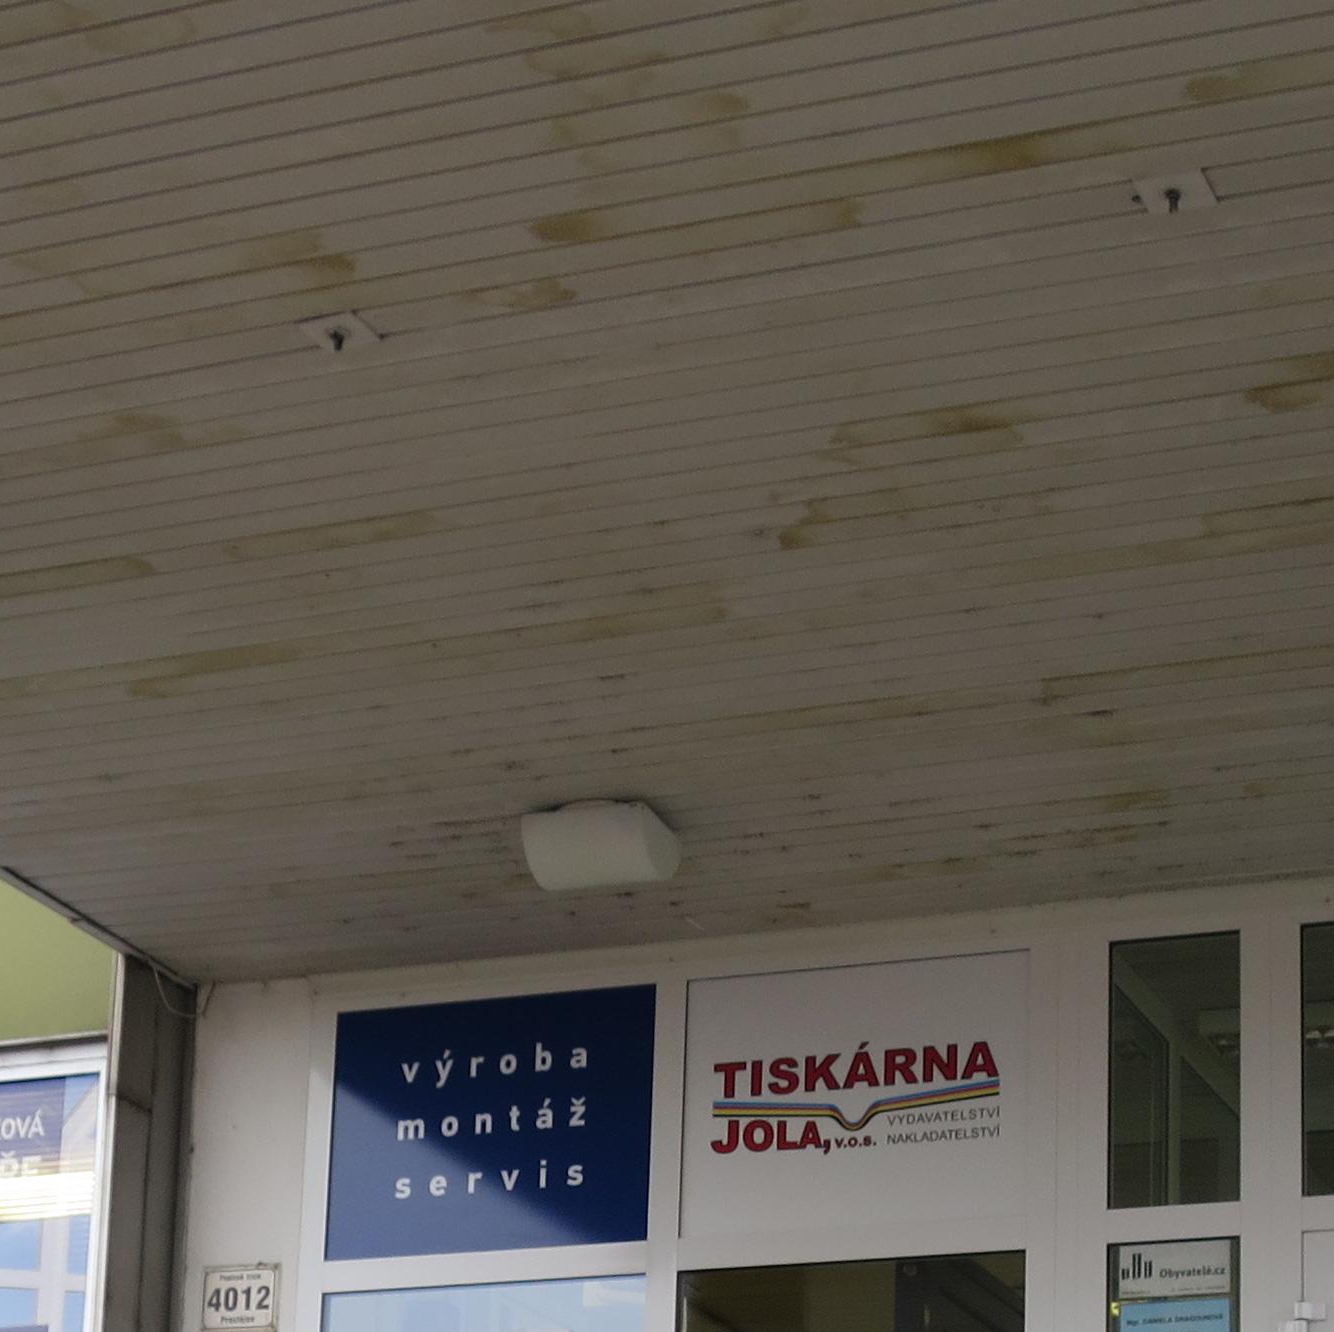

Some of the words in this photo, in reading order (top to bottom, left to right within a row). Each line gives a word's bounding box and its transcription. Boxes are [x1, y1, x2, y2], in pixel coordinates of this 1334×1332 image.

[400, 1042, 588, 1088] výroba
[713, 1041, 1000, 1098] TISKÁRNA
[396, 1097, 586, 1141] montáž
[886, 1105, 1001, 1126] VYDAVATELSTVÍ
[710, 1119, 831, 1154] JOLA,
[886, 1126, 1001, 1145] NAKLADATELSTVÍ
[394, 1159, 584, 1199] servis
[207, 1285, 271, 1312] 4012
